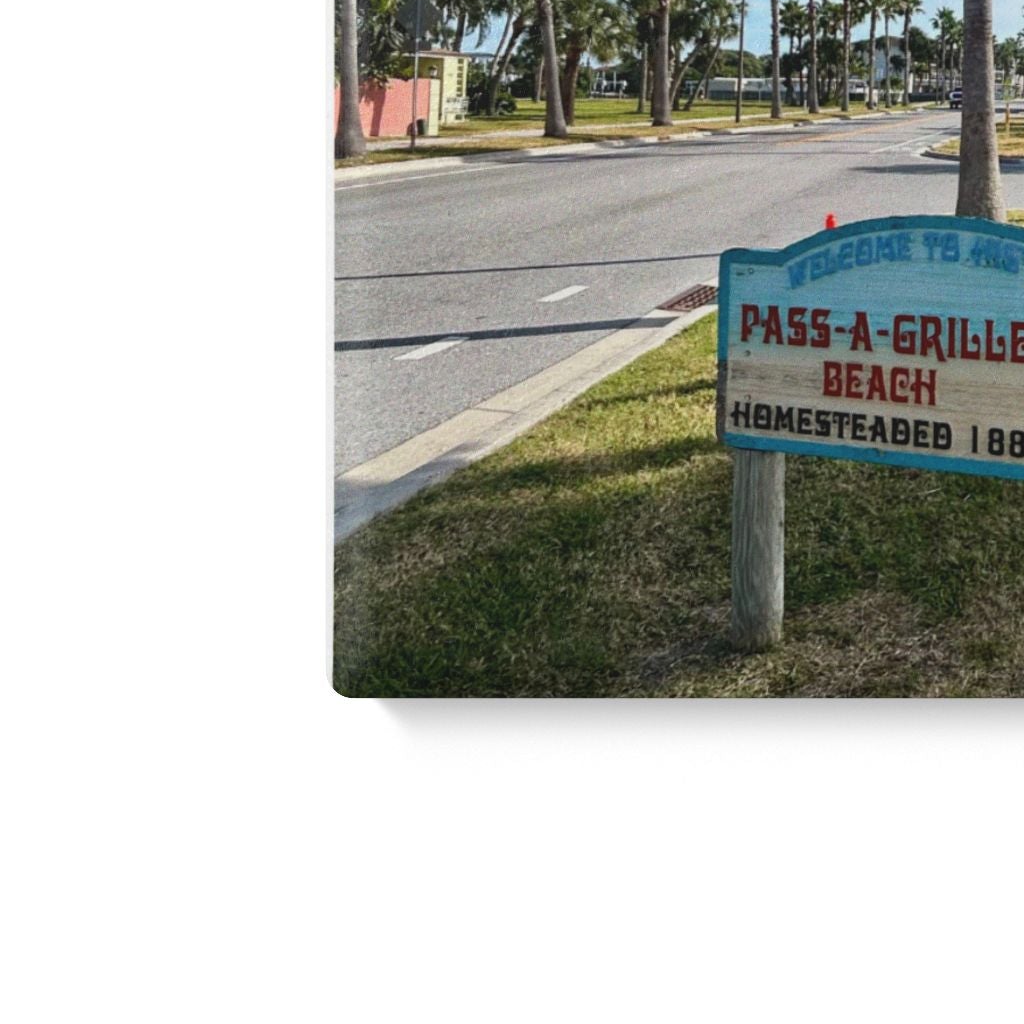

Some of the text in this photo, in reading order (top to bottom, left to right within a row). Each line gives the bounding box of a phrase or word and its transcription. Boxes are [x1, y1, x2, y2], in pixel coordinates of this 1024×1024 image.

[787, 231, 913, 290] WELCOME
[922, 230, 961, 262] TO
[822, 360, 938, 406] BEACH
[730, 400, 953, 450] HOMESTEADED
